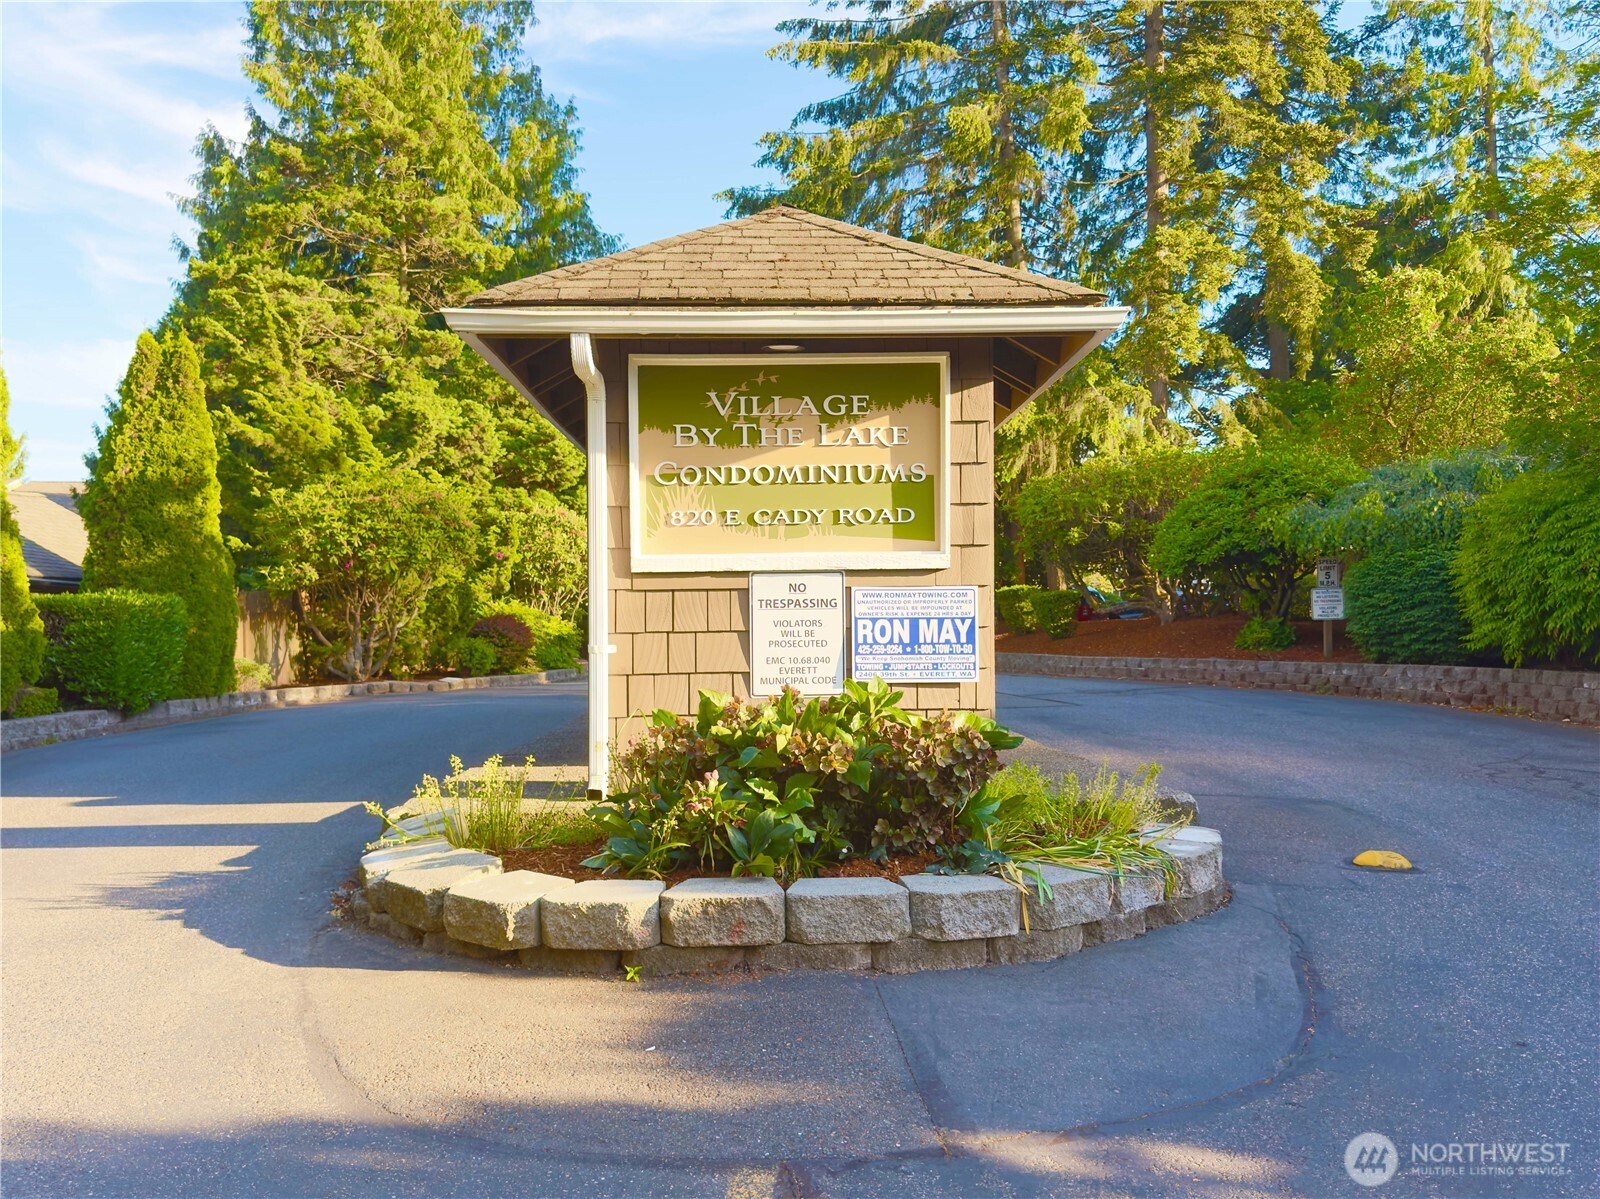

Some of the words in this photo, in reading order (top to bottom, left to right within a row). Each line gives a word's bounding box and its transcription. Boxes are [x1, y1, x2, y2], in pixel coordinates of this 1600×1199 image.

[706, 391, 870, 417] VILLAGE
[672, 424, 723, 447] BY
[732, 423, 804, 447] THE
[818, 423, 909, 447] LAKE
[654, 461, 927, 486] CONDOMINIUMS
[670, 510, 717, 527] 820
[725, 510, 744, 525] E.
[753, 508, 829, 525] CADY
[838, 507, 915, 525] ROAD
[1324, 572, 1331, 580] 5
[788, 583, 807, 592] NO
[758, 598, 838, 609] TRESPASSING
[773, 619, 823, 628] VIOLATORS
[857, 619, 910, 644] RON
[919, 619, 972, 643] MAY
[914, 644, 973, 654] 1-800-TOW-TO-GO
